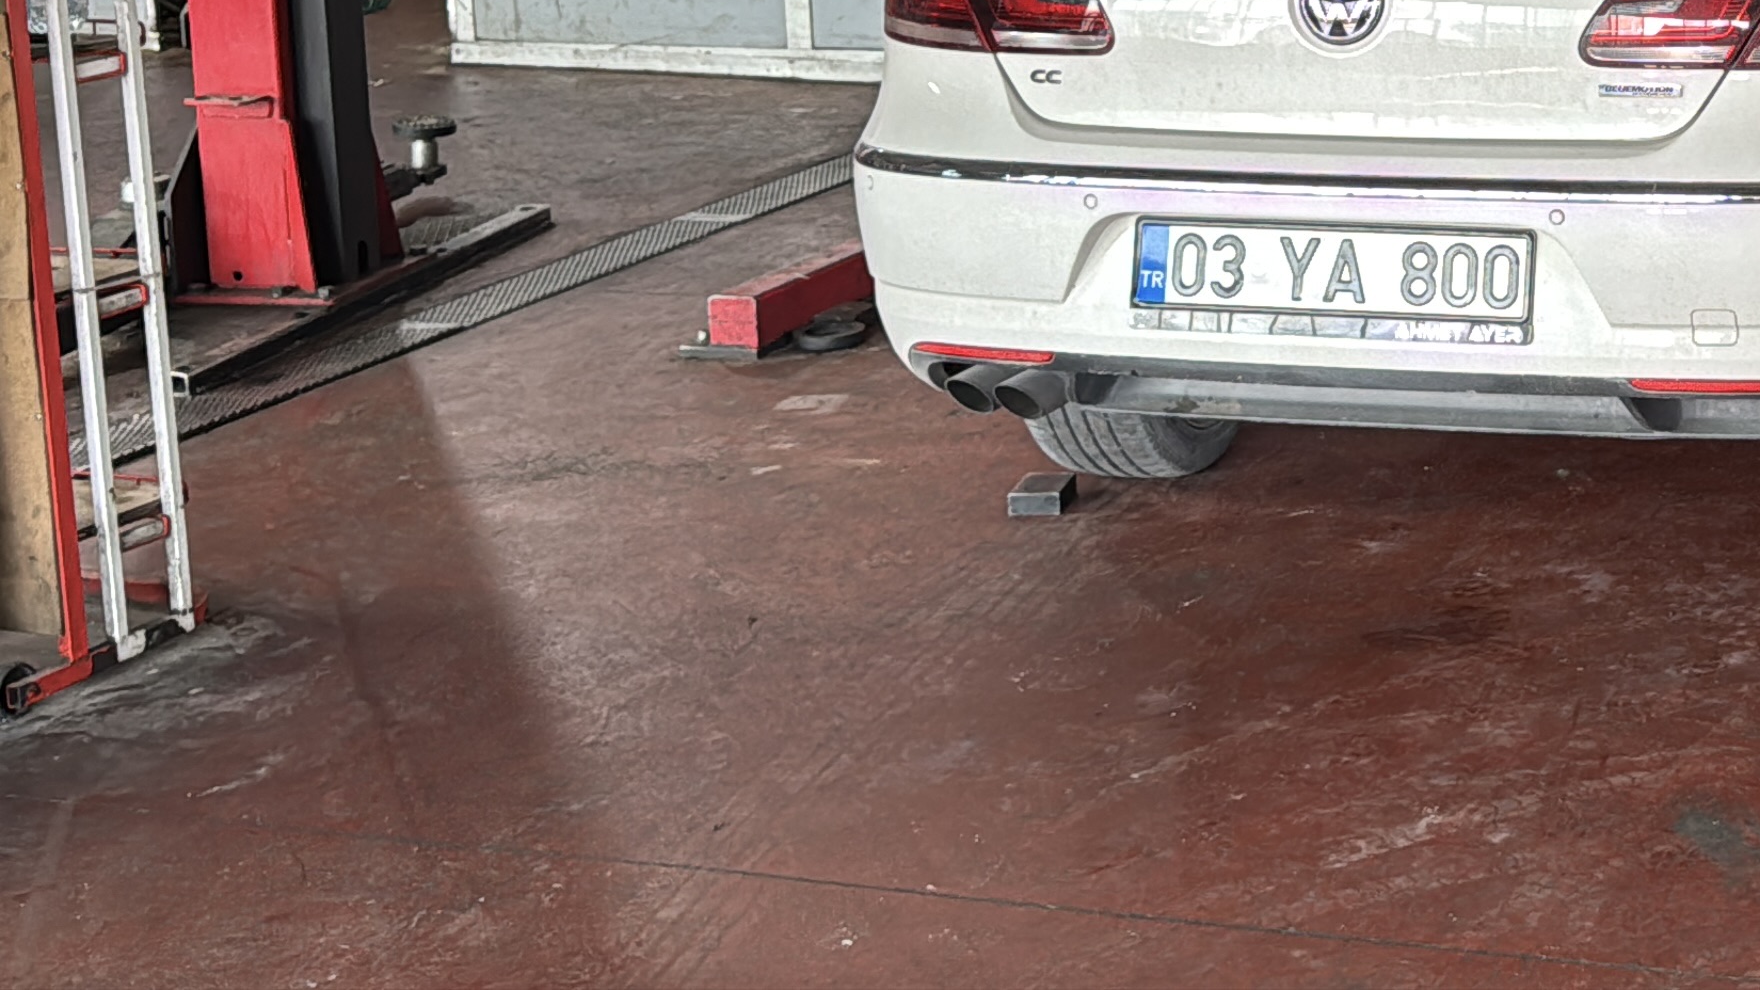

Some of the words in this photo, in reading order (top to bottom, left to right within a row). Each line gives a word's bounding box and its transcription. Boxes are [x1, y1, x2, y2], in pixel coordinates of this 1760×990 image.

[1030, 69, 1062, 84] CC
[1140, 270, 1165, 288] TR
[1172, 232, 1246, 299] 03
[1280, 236, 1366, 304] YA
[1400, 241, 1520, 309] 800
